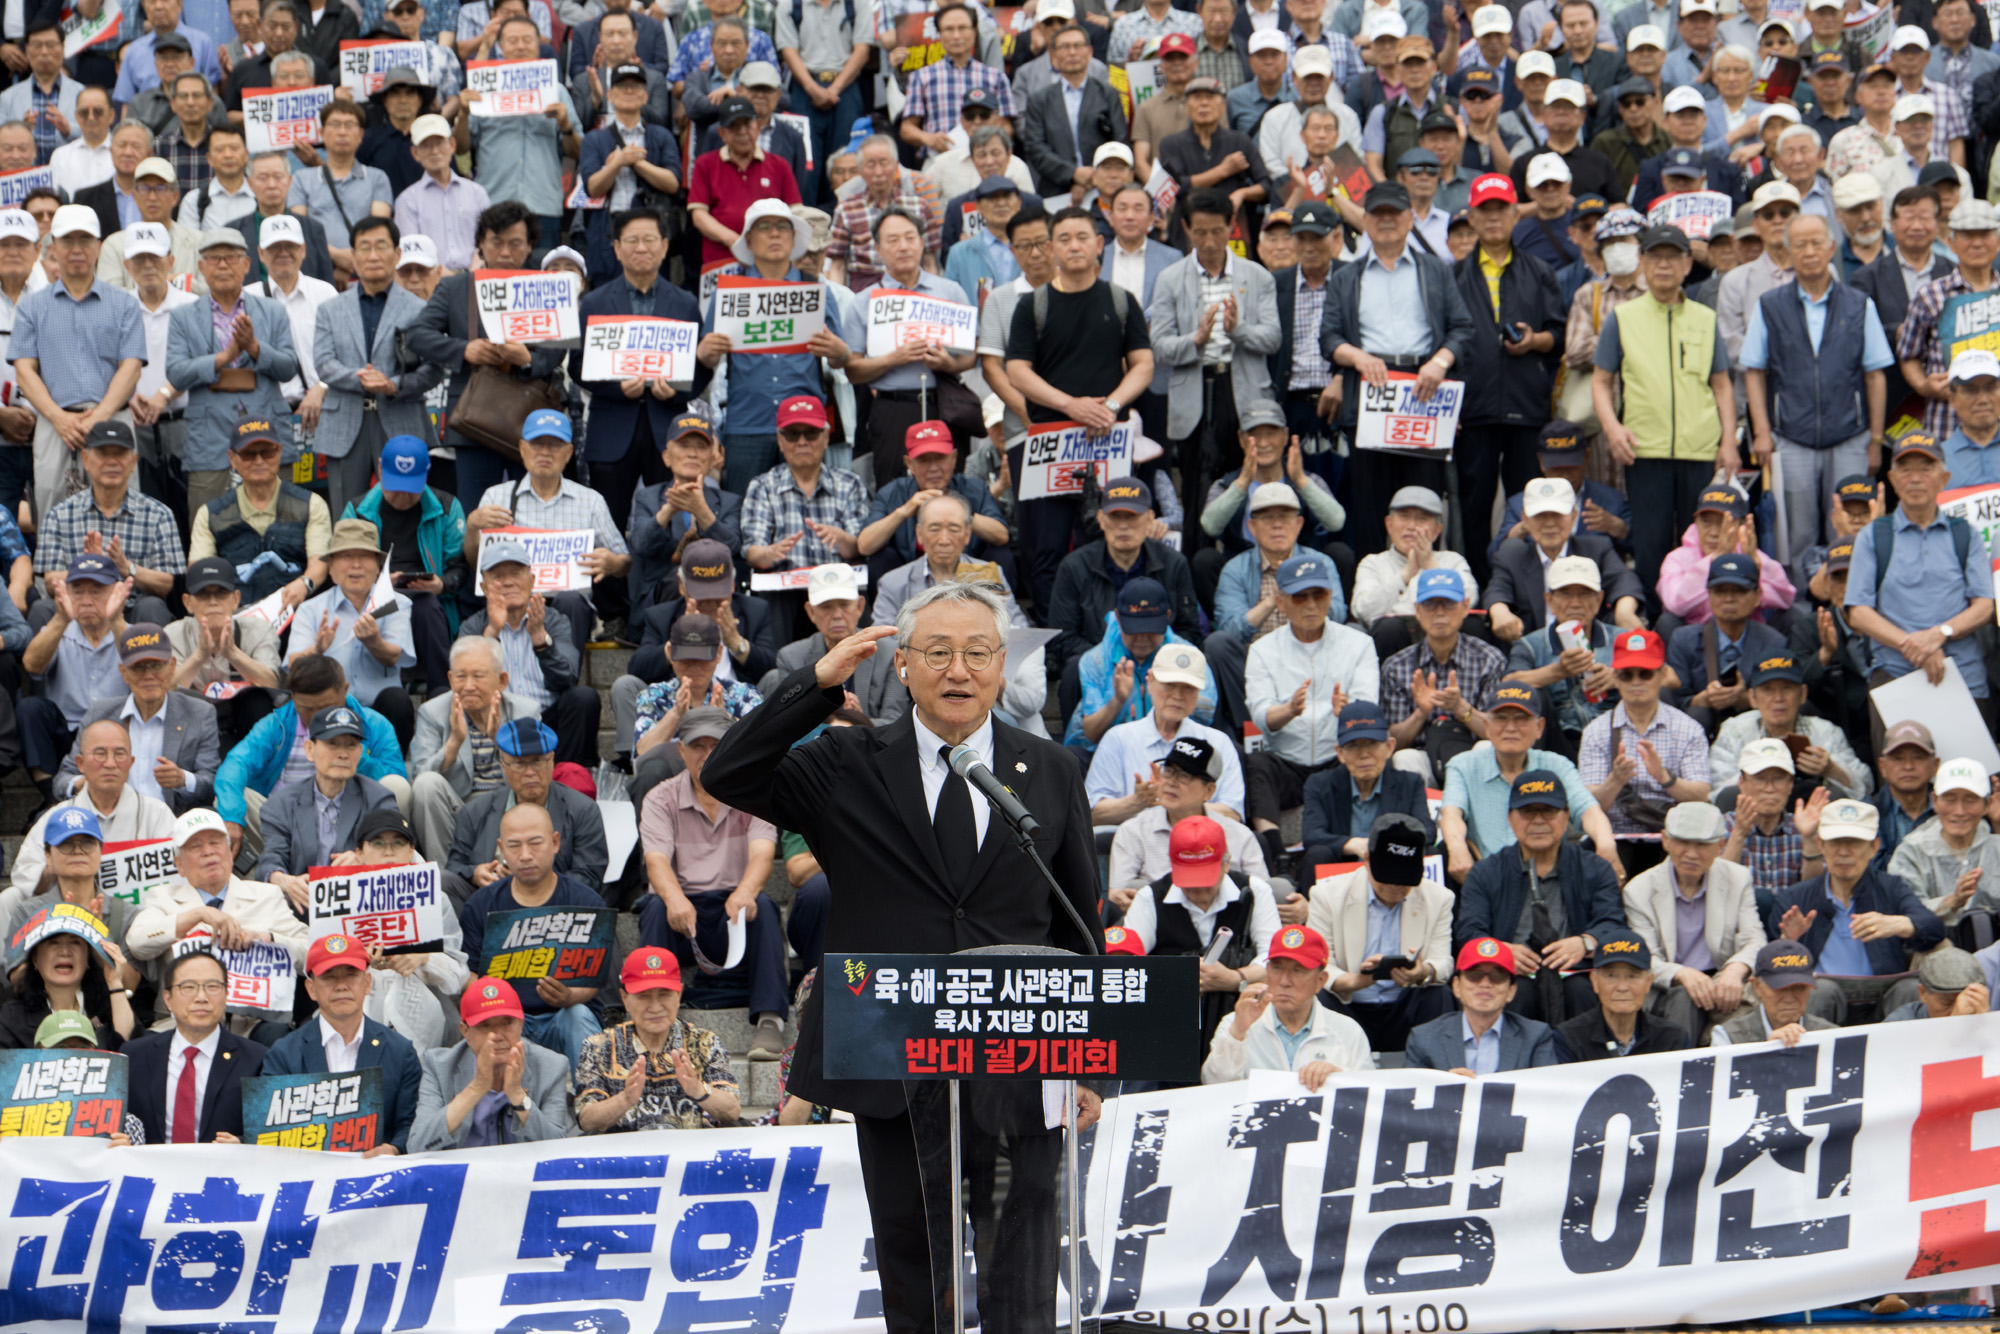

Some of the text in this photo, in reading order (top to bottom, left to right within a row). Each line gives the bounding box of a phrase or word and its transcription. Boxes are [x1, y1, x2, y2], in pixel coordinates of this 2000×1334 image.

[345, 51, 370, 74] 국방
[472, 65, 554, 92] 안보 자해행위
[247, 99, 274, 123] 국방
[500, 91, 534, 110] 중단
[275, 120, 317, 145] 중단
[480, 277, 573, 312] 안보 자해행위
[721, 287, 820, 318] 태릉 자연환경
[508, 313, 552, 339] 중단
[874, 296, 973, 329] 안보 자해행위
[590, 323, 692, 354] 국방 파괴행위
[743, 318, 795, 344] 보전
[620, 352, 666, 378] 중단
[1365, 383, 1397, 413] 안보
[1391, 418, 1431, 443] 중단
[1028, 434, 1059, 467] 안보
[1829, 544, 1853, 560] KM
[101, 847, 179, 890] 릉 자연환
[314, 869, 436, 919] 안보 자해행위
[353, 916, 408, 943] 중단
[501, 911, 598, 950] 사관학교
[486, 946, 607, 980] 통폐합 반대
[1602, 940, 1640, 955] KMA
[1771, 954, 1808, 968] KMA
[843, 958, 867, 983] 졸속
[874, 968, 1148, 1004] 육·해·공군 사관학교 통합
[934, 1009, 1089, 1033] 육사 지방 이전
[906, 1038, 1117, 1075] 반대 궐기대회
[11, 1056, 110, 1101] 사관학교
[72, 1096, 122, 1137] 반대
[264, 1075, 361, 1127] 사관학교
[329, 1111, 379, 1152] 반대
[1200, 1082, 1527, 1307] 지방
[1560, 1034, 1869, 1274] 이전
[1349, 1302, 1469, 1334] 11:00
